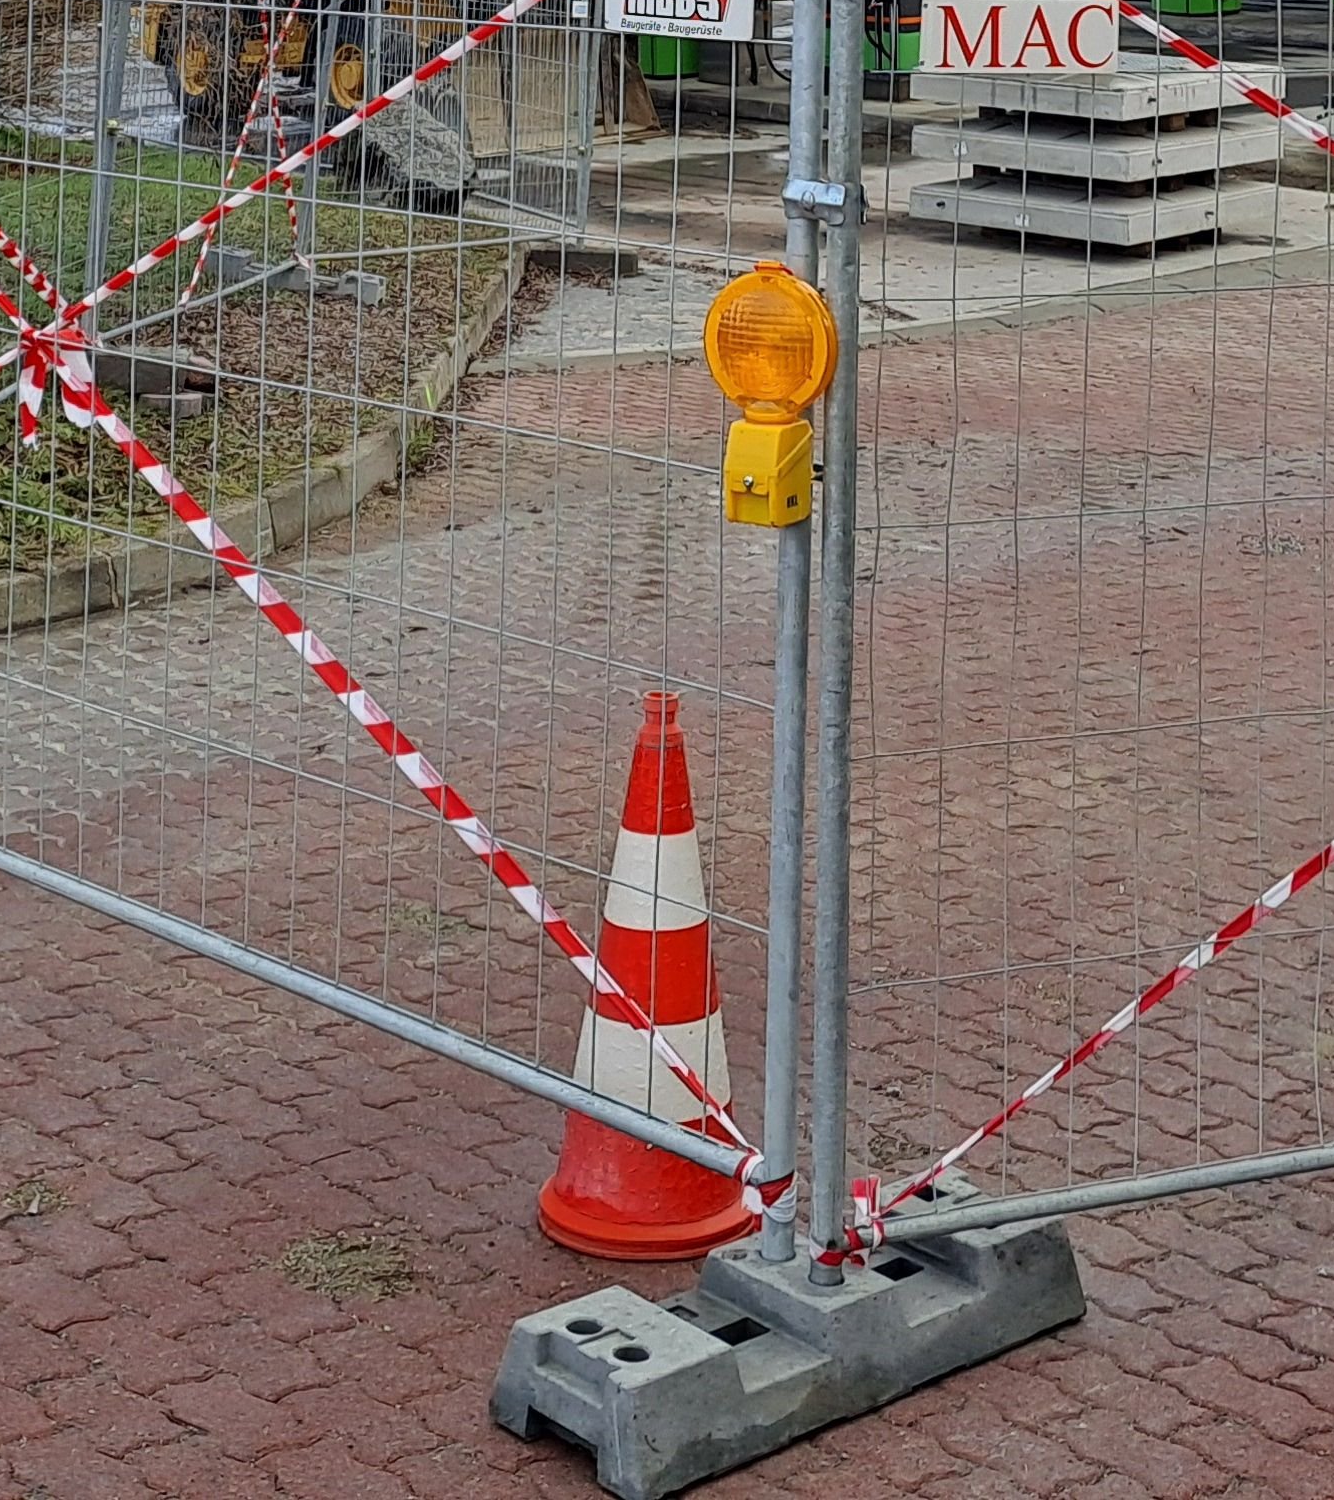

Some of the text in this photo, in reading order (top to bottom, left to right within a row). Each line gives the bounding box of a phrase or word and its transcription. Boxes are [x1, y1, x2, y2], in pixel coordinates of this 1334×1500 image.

[620, 18, 723, 36] Baugeräte Baugerüste
[934, 4, 1114, 68] MAC
